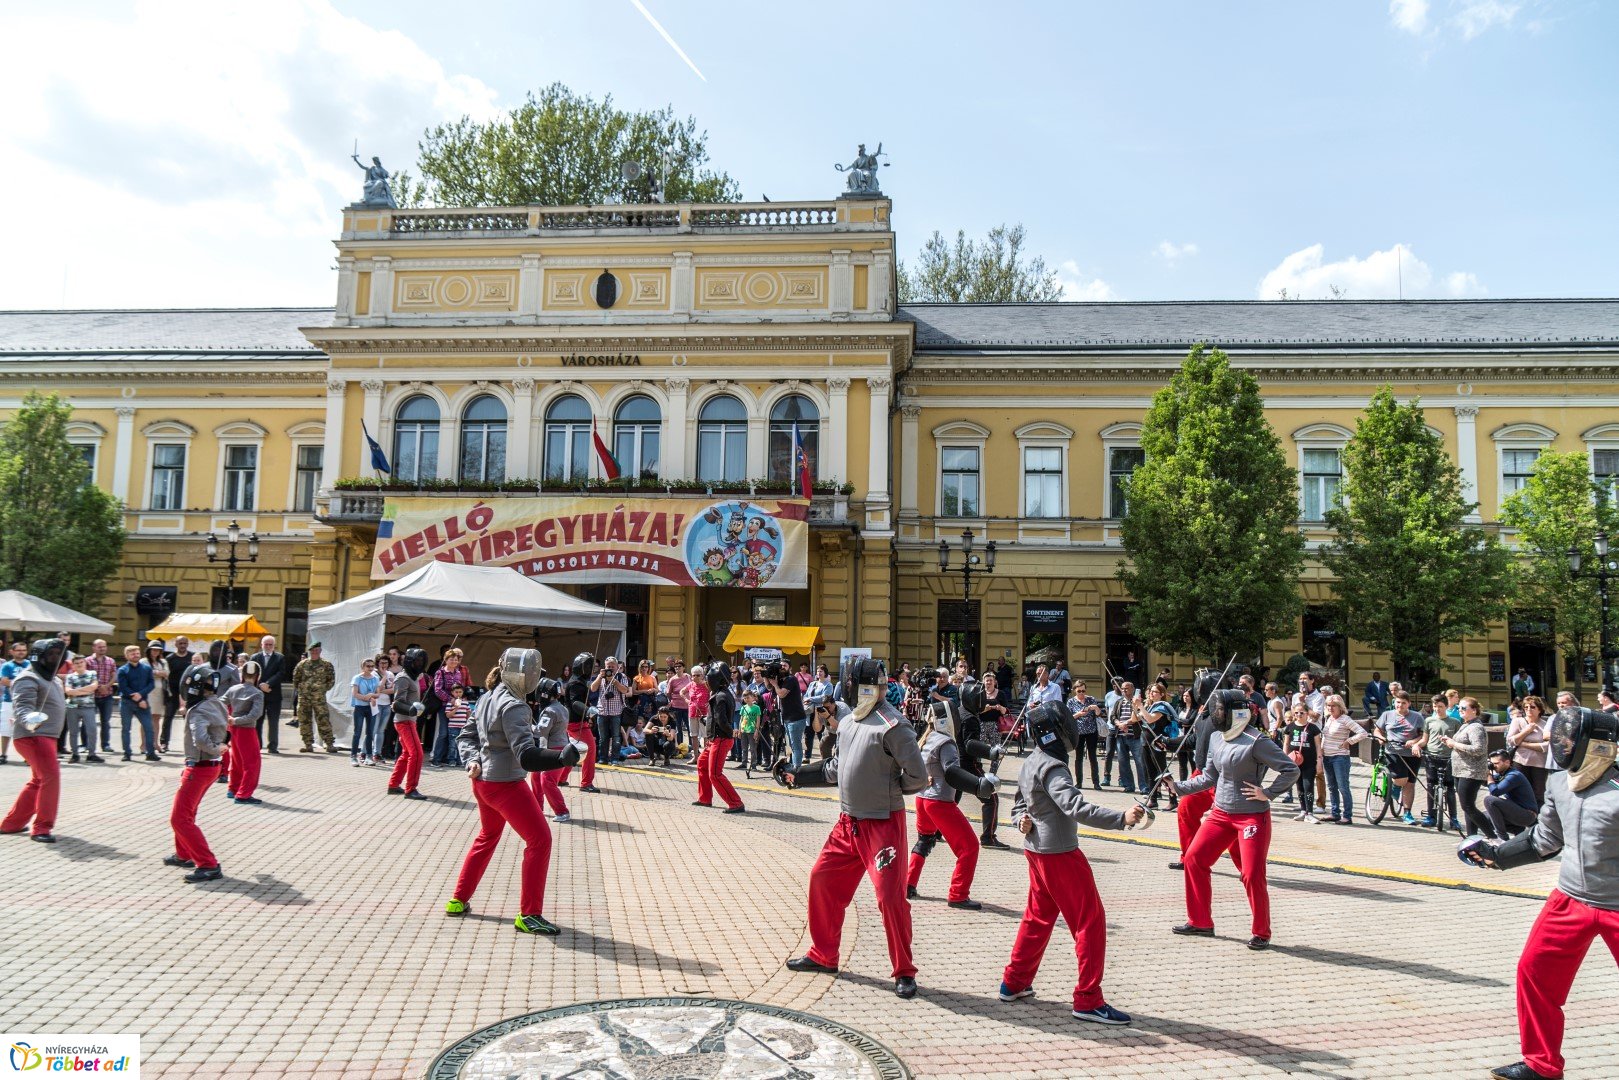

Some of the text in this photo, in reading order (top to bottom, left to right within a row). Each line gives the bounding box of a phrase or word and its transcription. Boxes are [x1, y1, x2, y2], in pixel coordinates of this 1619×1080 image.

[560, 352, 642, 366] VÁROSHÁZA
[378, 501, 494, 574] HELLÓ
[434, 503, 685, 565] NYÍREGYHÁZA!
[533, 554, 600, 573] MOSOLY
[607, 554, 659, 571] NAPJA
